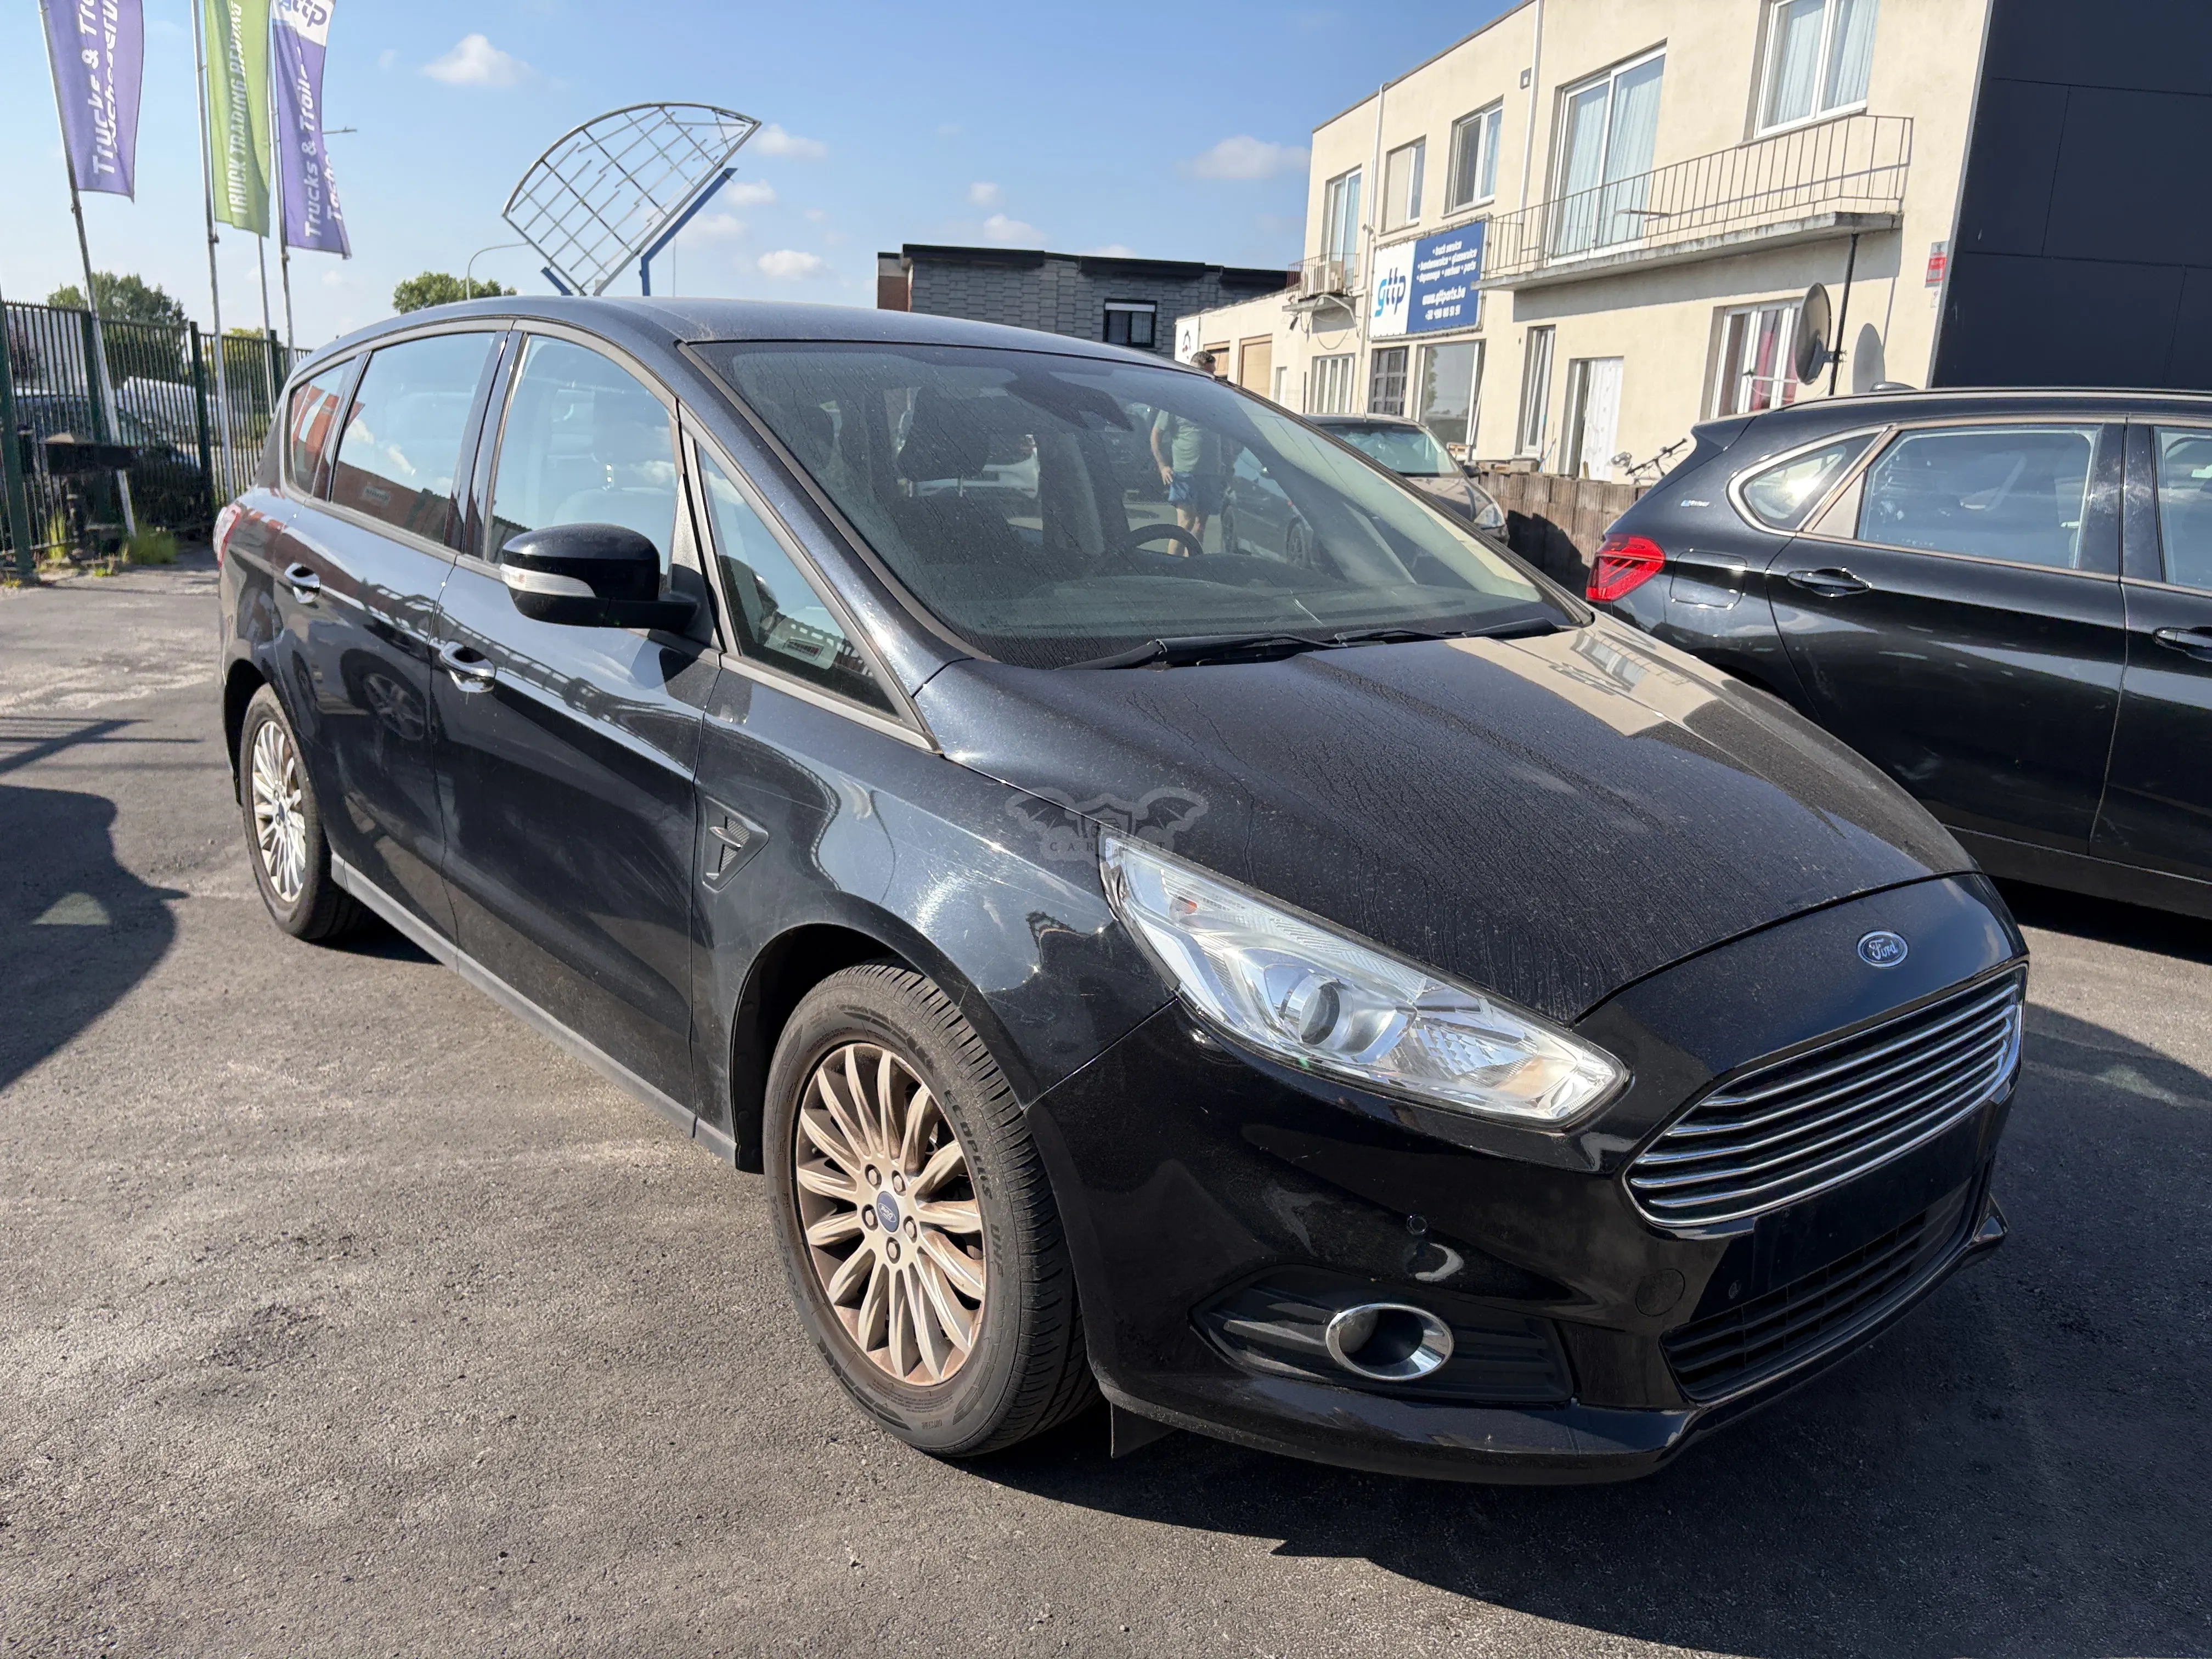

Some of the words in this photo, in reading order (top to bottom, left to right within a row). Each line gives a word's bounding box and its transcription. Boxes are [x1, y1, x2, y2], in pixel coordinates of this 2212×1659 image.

[81, 49, 99, 69] &
[229, 78, 246, 155] TRADING
[302, 140, 318, 156] &
[228, 157, 247, 214] TRUCK
[303, 162, 321, 237] Trucks
[1374, 267, 1406, 317] gttp
[1869, 938, 1898, 960] Ford
[944, 1090, 992, 1200] ECOPLUS
